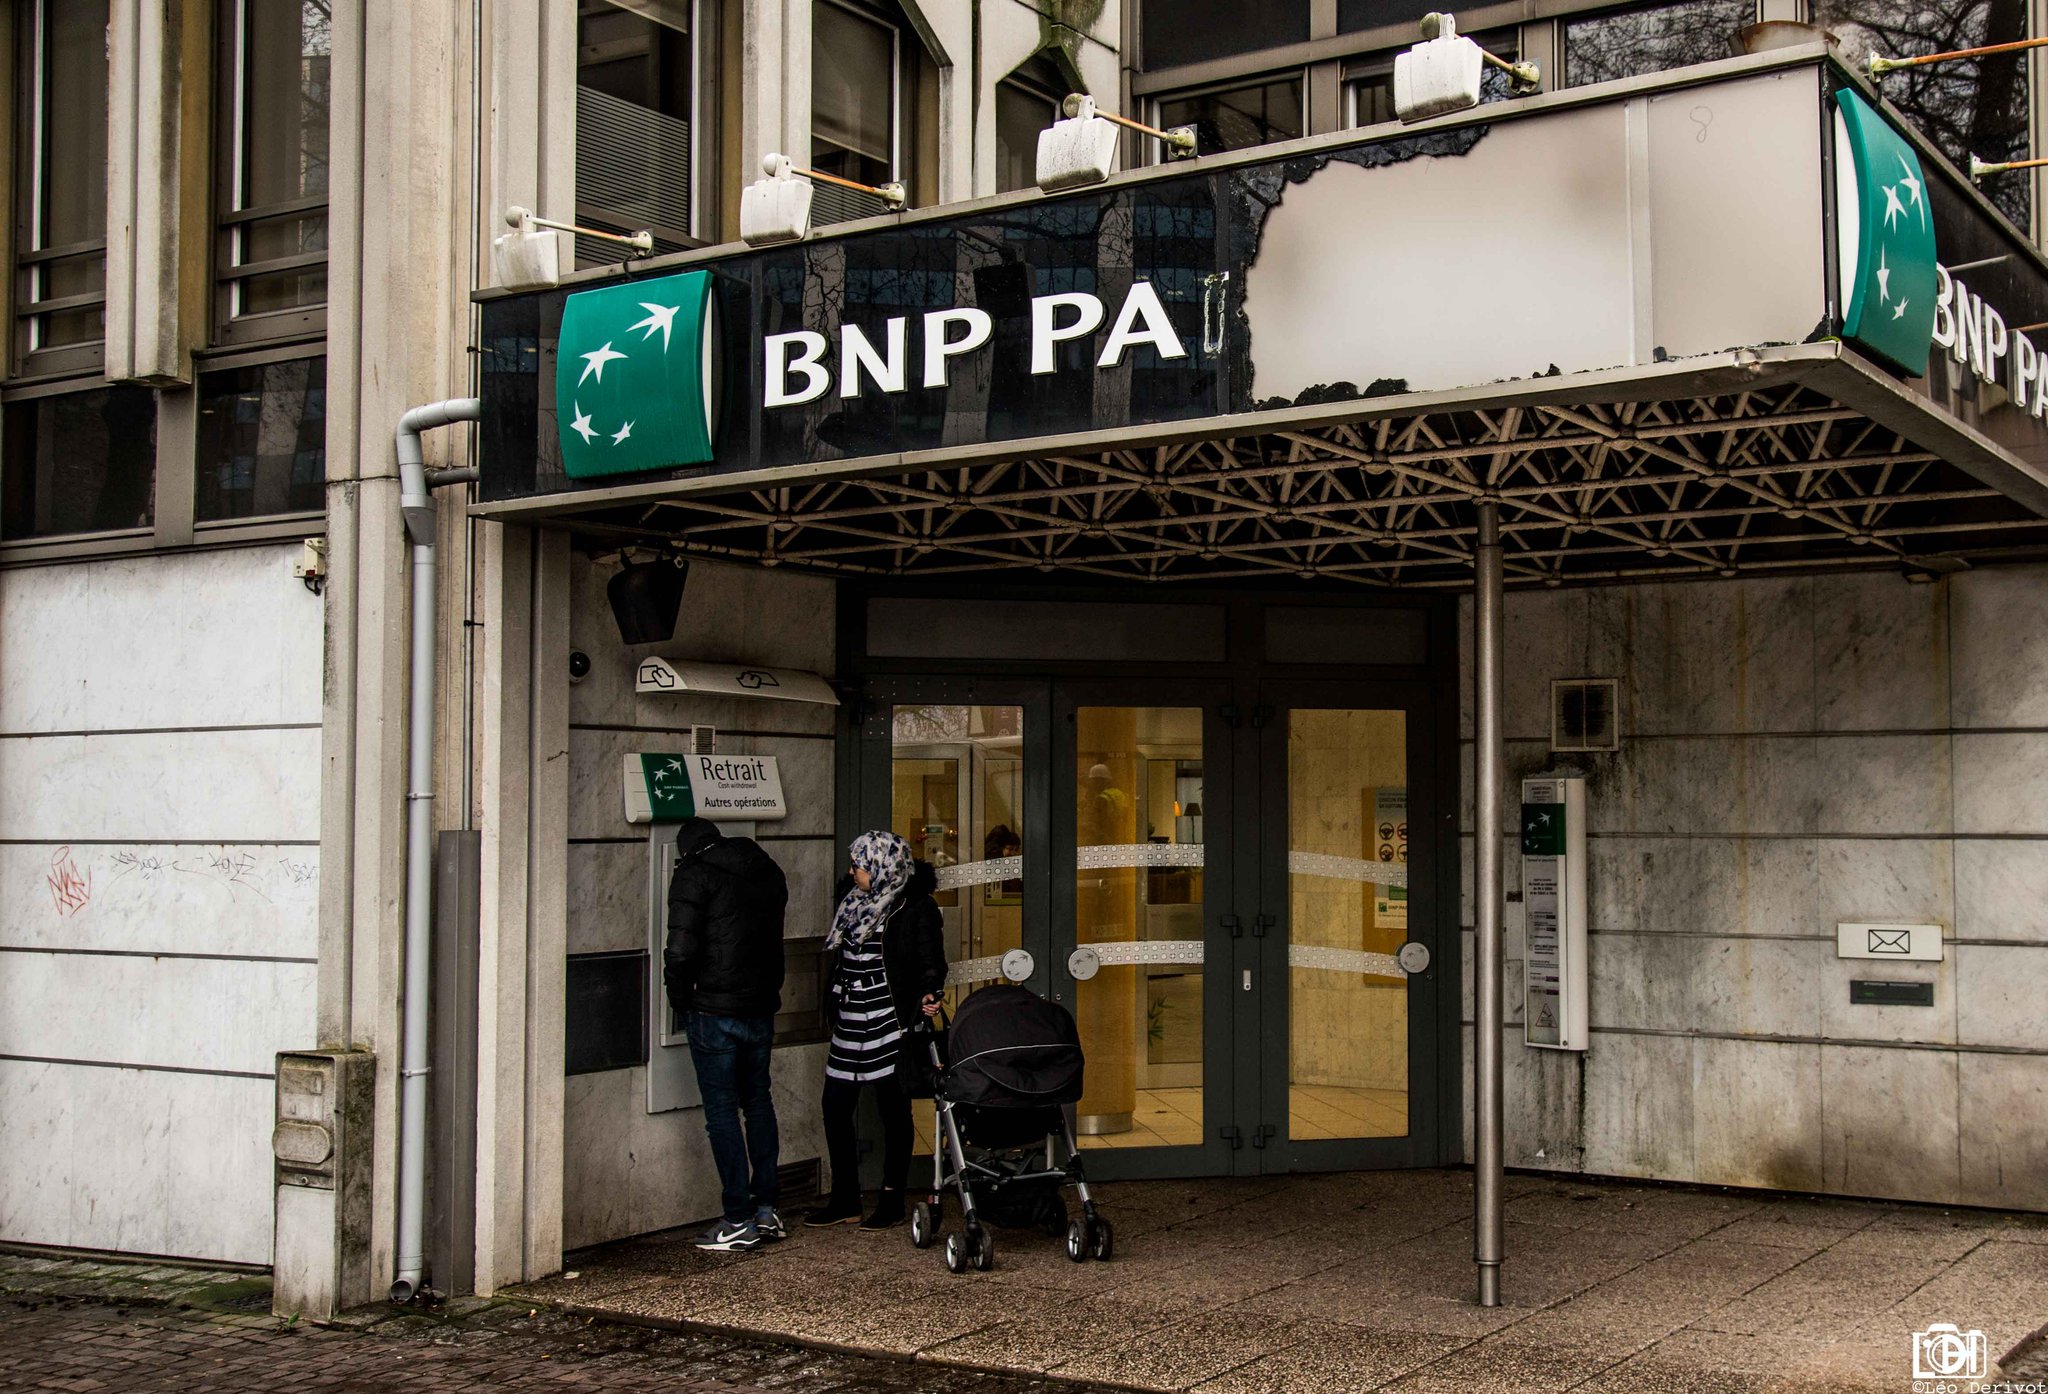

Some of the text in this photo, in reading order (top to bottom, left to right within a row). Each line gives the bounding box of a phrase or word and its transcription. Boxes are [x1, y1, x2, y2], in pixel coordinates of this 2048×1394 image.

[1932, 261, 2008, 385] BNP
[763, 307, 994, 409] BNP
[700, 757, 767, 781] Retrait
[705, 796, 777, 810] Autres opérations
